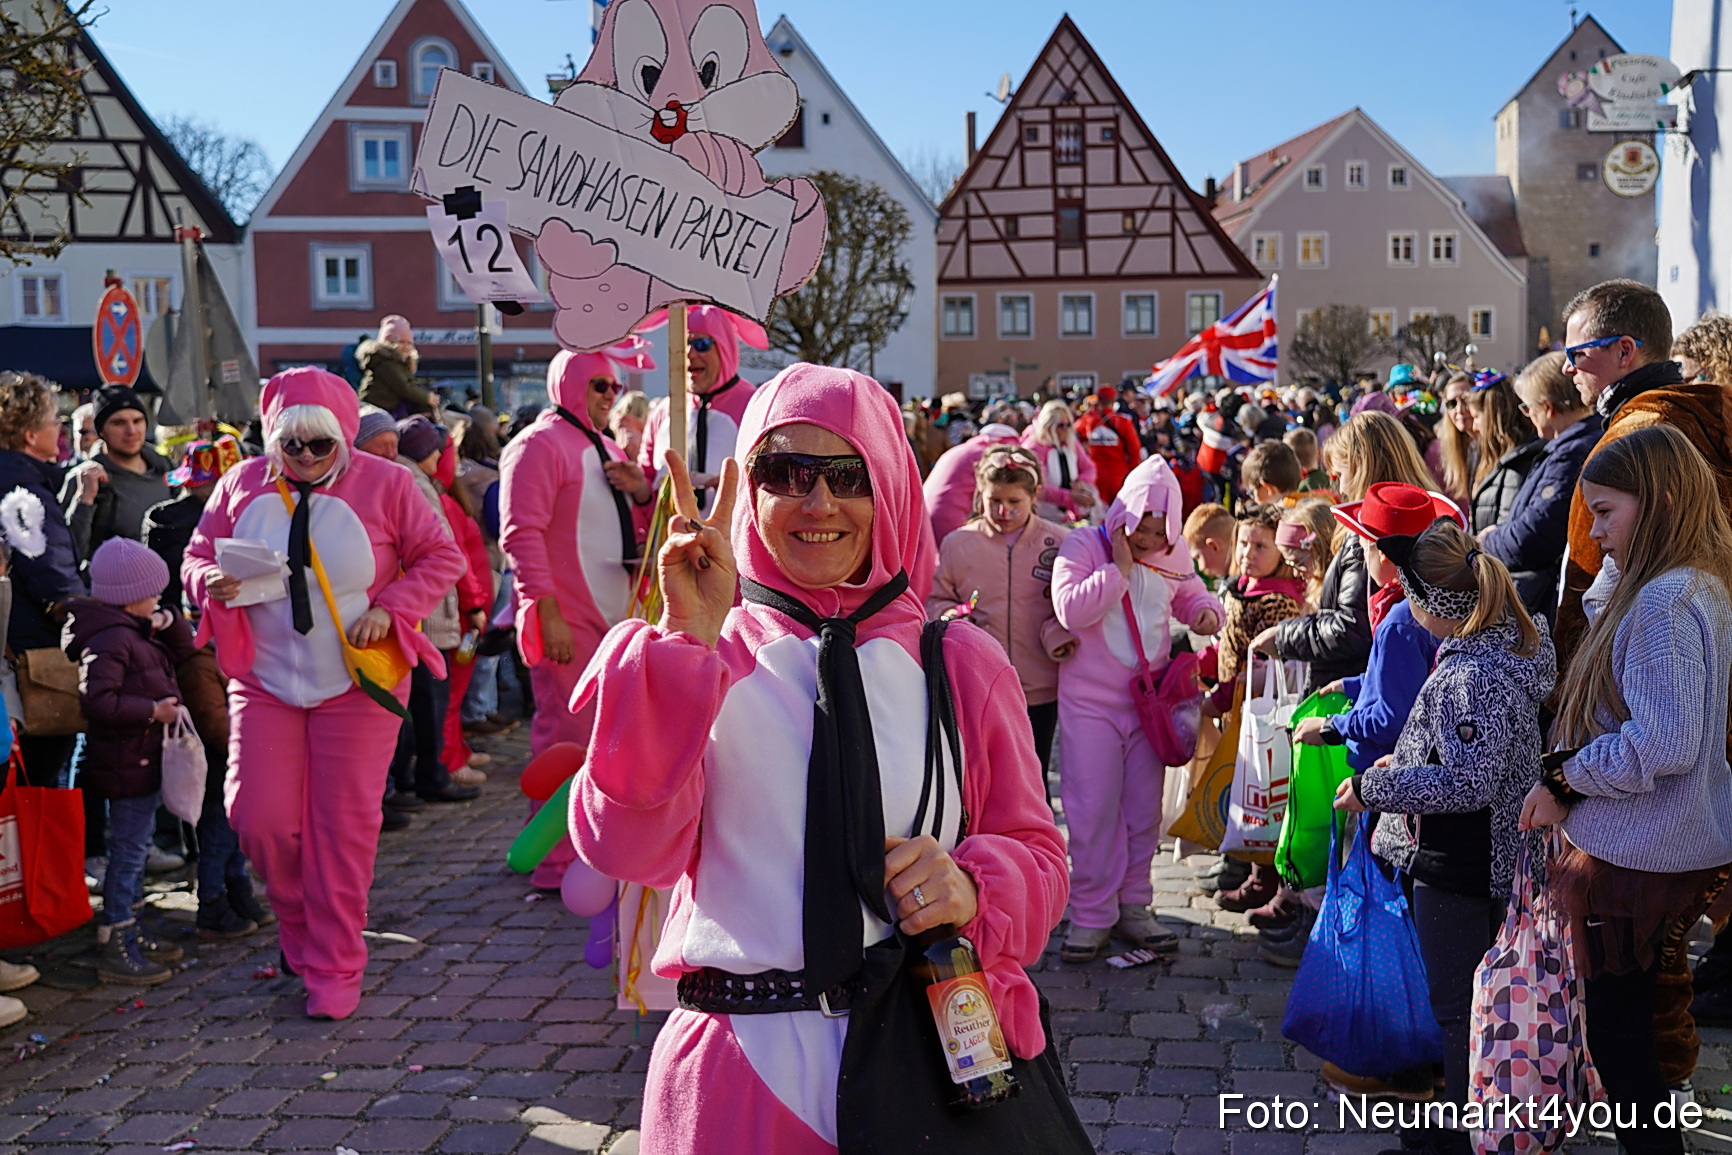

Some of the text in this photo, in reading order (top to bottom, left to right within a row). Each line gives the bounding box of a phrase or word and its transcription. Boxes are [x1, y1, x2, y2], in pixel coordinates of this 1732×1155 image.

[437, 102, 780, 280] DIE SANDHASEN PARTEI
[446, 223, 514, 274] 12
[1242, 813, 1269, 827] MAX
[953, 1019, 991, 1036] Reuther
[962, 1031, 987, 1050] LAGER
